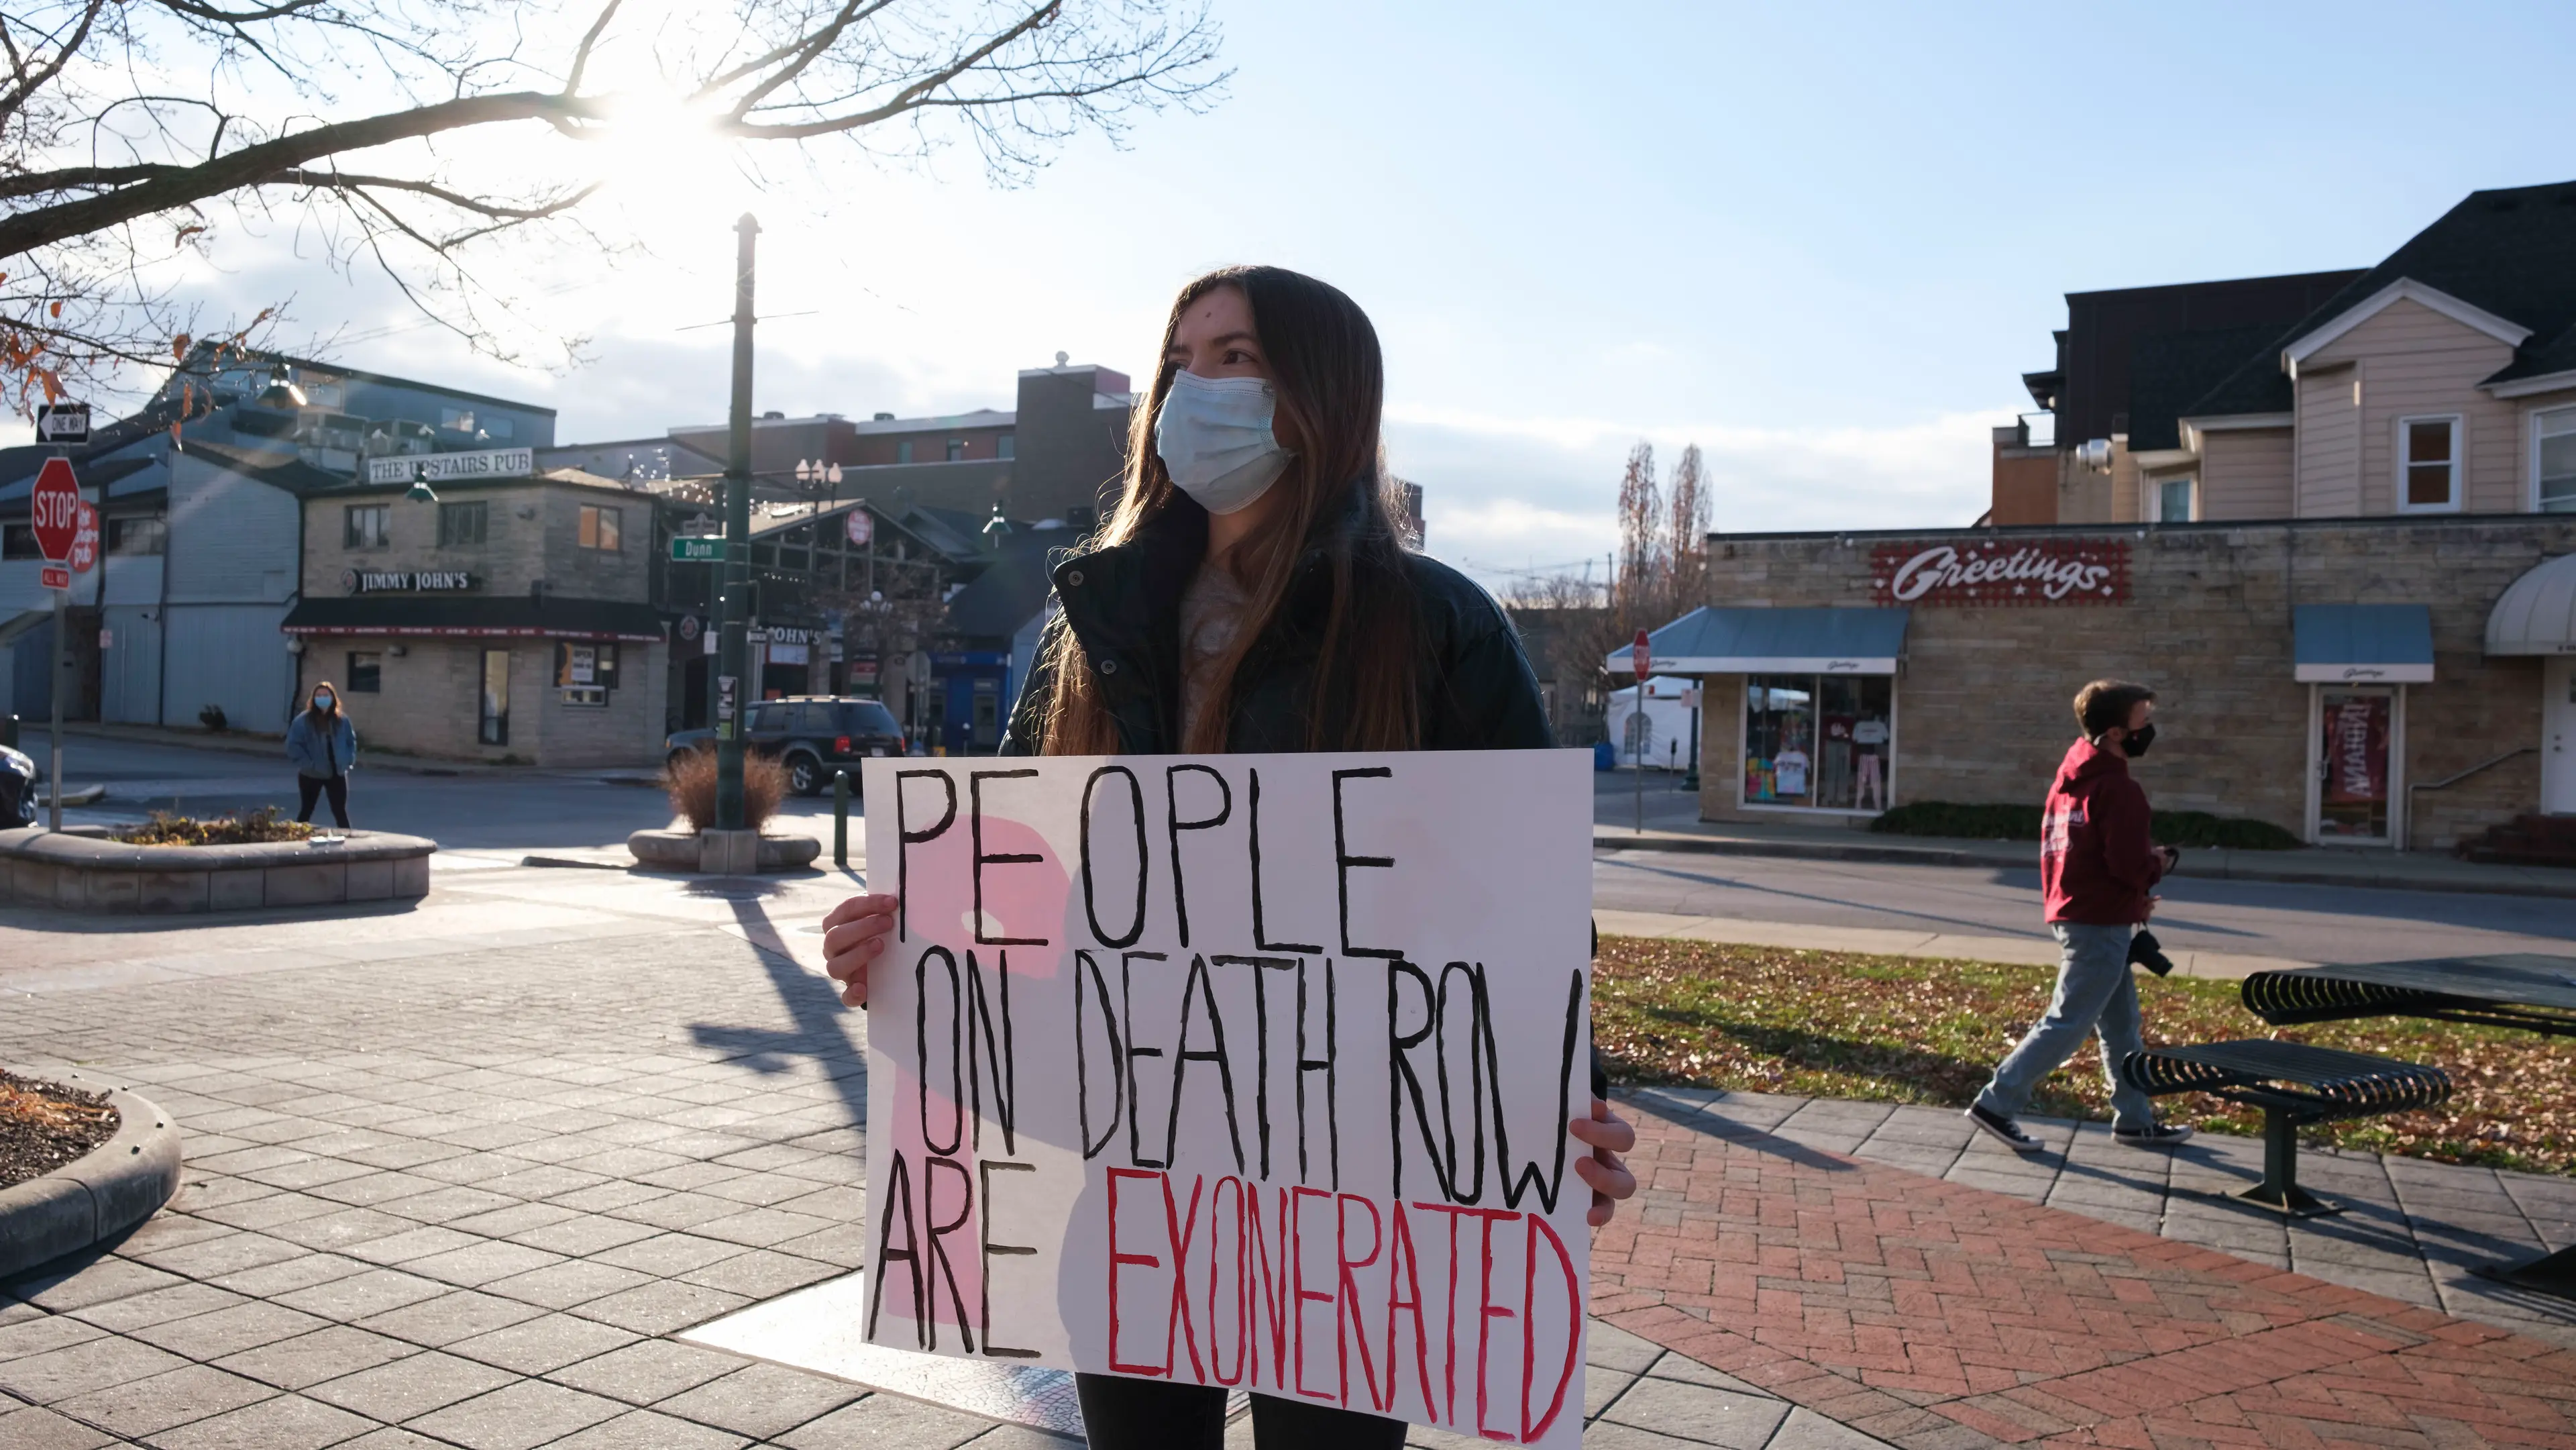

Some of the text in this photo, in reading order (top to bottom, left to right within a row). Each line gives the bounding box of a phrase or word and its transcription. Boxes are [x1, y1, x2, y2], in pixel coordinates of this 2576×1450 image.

[52, 415, 85, 431] ONE WAY
[372, 454, 529, 478] THE UPSTAIRS PUB
[36, 490, 76, 529] STOP
[686, 541, 712, 556] Dunn
[362, 573, 409, 592] JIMMY
[415, 572, 468, 592] JOHN'S
[1892, 546, 2110, 601] Greetings
[774, 626, 821, 645] OHN'S
[896, 764, 1403, 960] PEOPLE
[915, 945, 1583, 1214] ON DEATH ROW
[867, 1149, 1580, 1444] ARE EXONERATED
